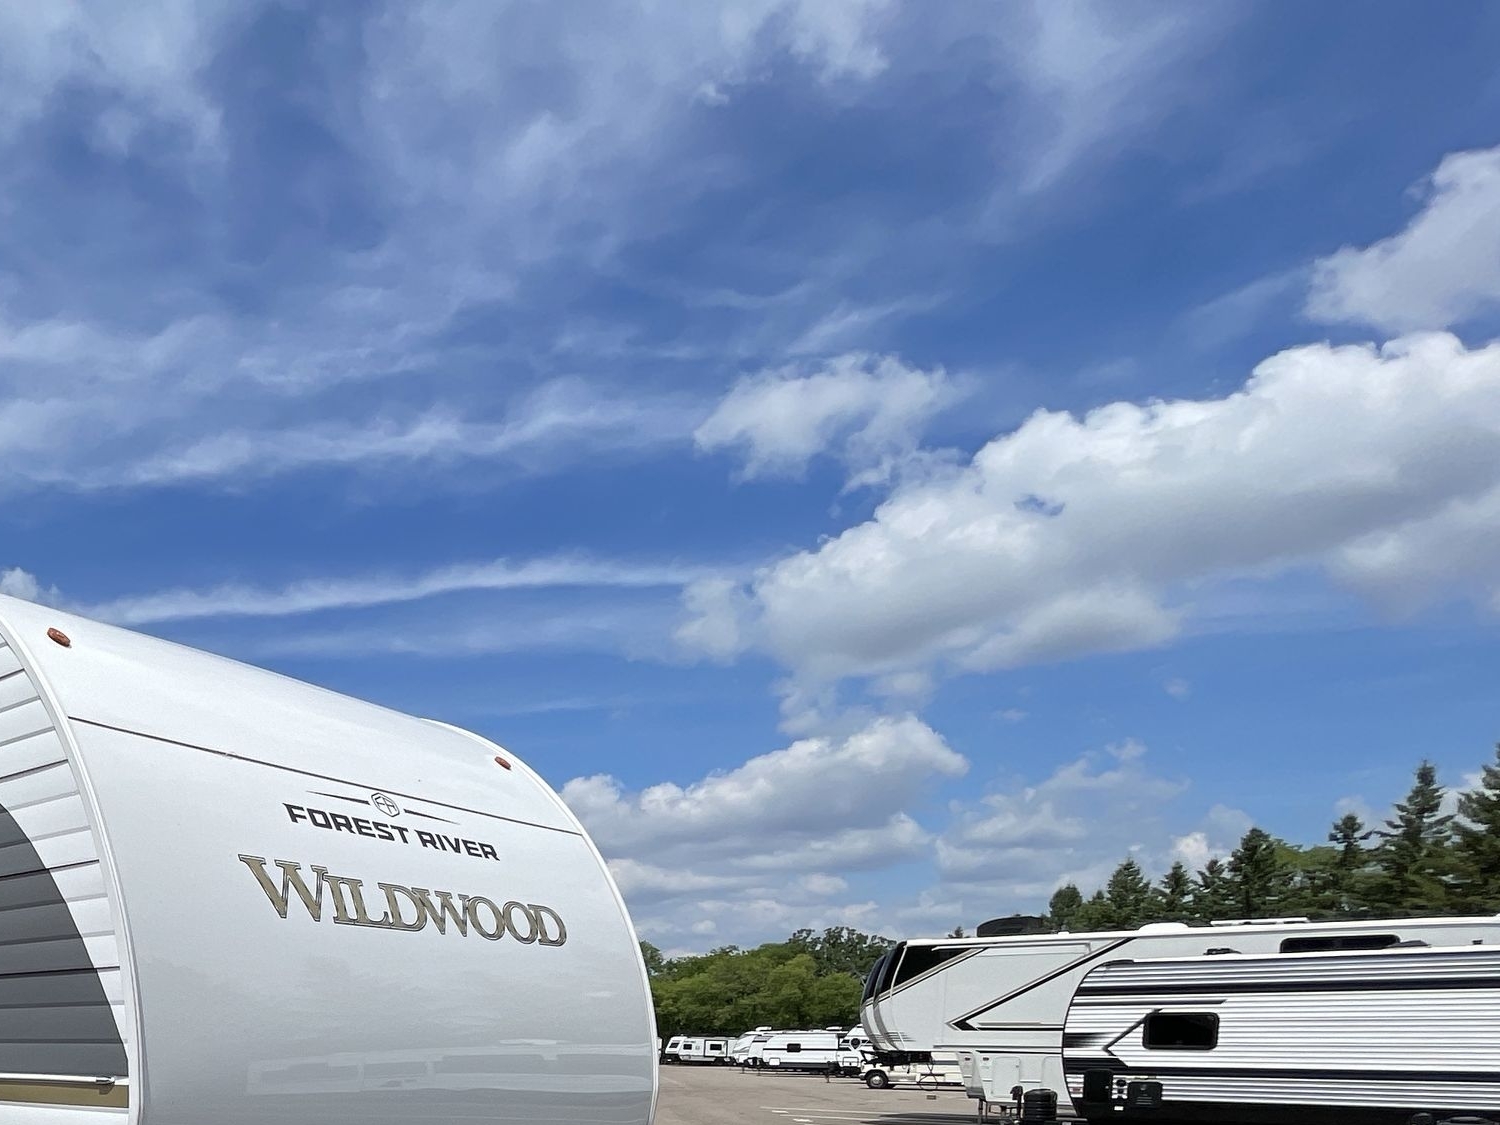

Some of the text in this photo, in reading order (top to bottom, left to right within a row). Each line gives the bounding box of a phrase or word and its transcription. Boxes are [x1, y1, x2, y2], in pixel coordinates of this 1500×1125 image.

[282, 802, 500, 861] FOREST RIVER
[237, 853, 568, 947] WILDWOOD
